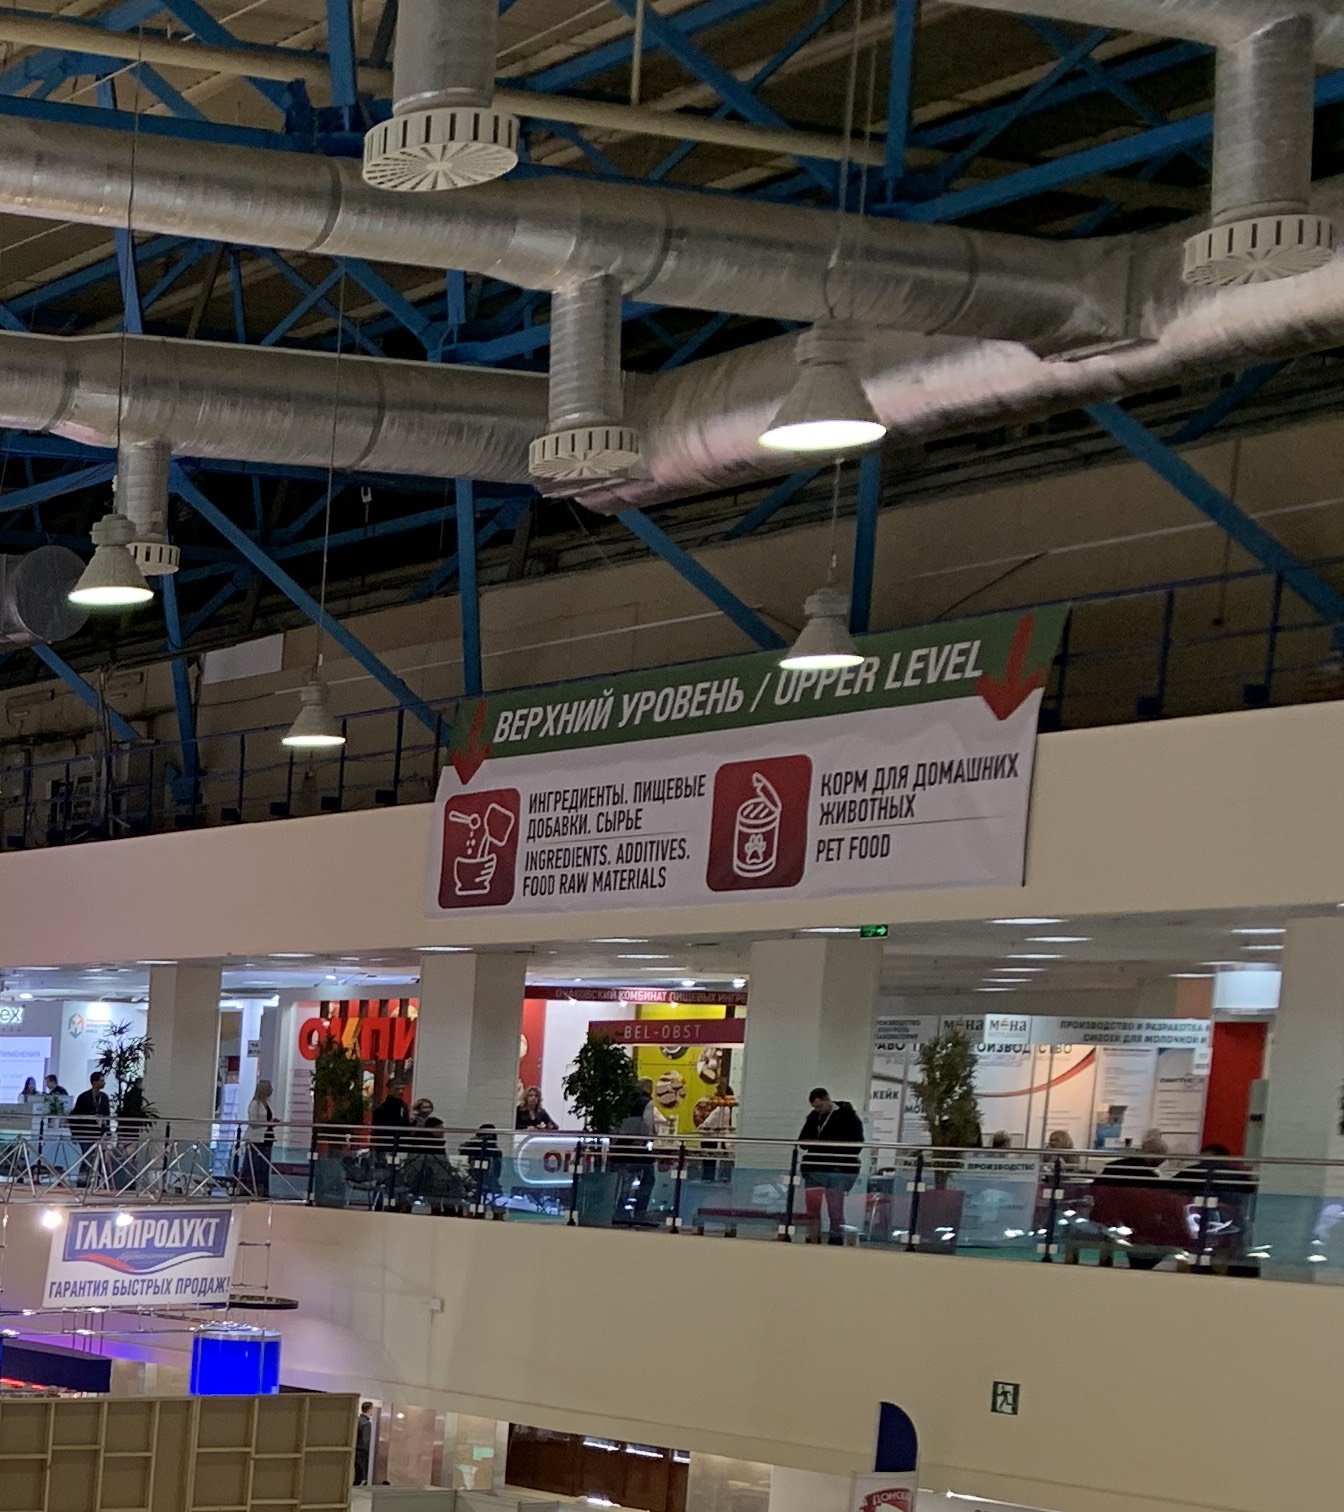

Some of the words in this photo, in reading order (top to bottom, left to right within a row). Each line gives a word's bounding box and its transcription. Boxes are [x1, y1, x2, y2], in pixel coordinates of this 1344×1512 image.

[493, 687, 615, 743] ВЕРХНИЙ
[618, 677, 744, 728] УРОВЕНЬ
[774, 656, 881, 706] UPPER
[884, 640, 983, 690] LEVEL
[633, 774, 707, 804] ПИЩЕВЫЕ
[820, 769, 869, 797] КОРМ
[872, 765, 910, 796] ДЛЯ
[912, 752, 1020, 792] ДОМАШНИХ
[526, 813, 591, 843] ДОБАВКИ.
[596, 808, 643, 833] СЫРЬЕ
[819, 793, 916, 827] ЖИВОТНЫХ
[815, 837, 845, 863] PET
[848, 834, 891, 860] FOOD
[522, 874, 555, 897] FOOD
[559, 871, 589, 895] RAW
[593, 866, 667, 892] MATERIALS
[618, 990, 667, 1002] КОМБИНАТ
[74, 1217, 220, 1251] ГЛАВПРОДУКТ
[49, 1279, 108, 1299] ГАРАНТИЯ
[112, 1278, 173, 1296] БЫСТРЫХ
[175, 1276, 230, 1298] ПРОДАЖ!
